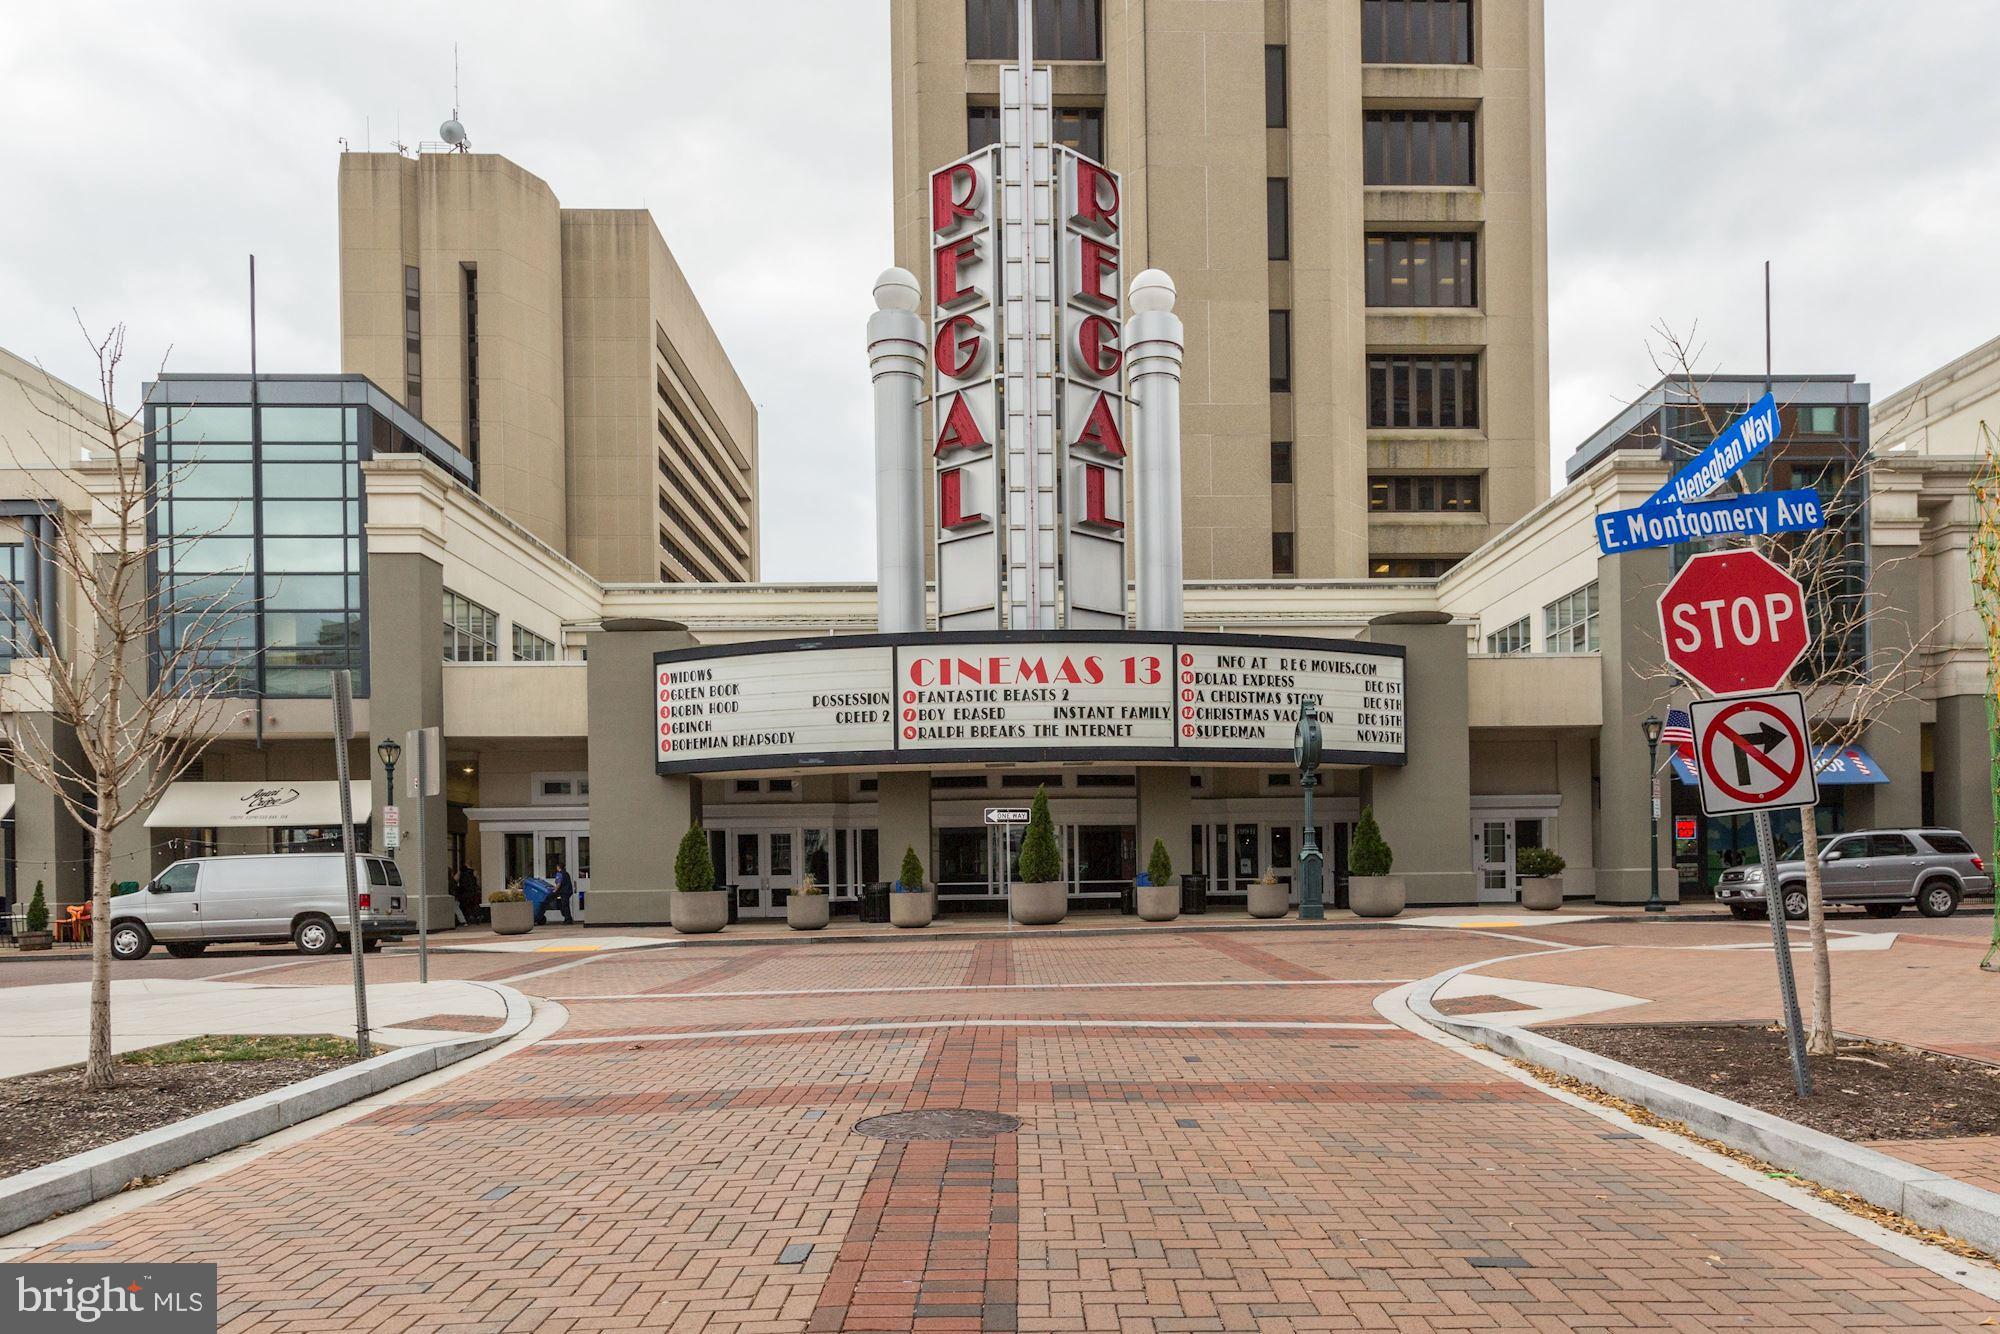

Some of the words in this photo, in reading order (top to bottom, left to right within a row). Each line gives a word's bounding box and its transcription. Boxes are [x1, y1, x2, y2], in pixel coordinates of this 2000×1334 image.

[933, 163, 988, 530] REGAL
[1072, 158, 1127, 530] REGAL
[1675, 439, 1743, 502] Heneghan
[1740, 409, 1774, 453] Way
[1777, 497, 1818, 527] Ave
[1672, 592, 1795, 653] STOP
[1218, 655, 1246, 668] INFO
[1251, 657, 1268, 669] AT
[670, 669, 712, 684] WIDOWS
[910, 656, 1104, 687] CINEMAS
[1120, 656, 1162, 685] 13
[1195, 673, 1237, 685] POLAR
[1243, 675, 1295, 687] EXPRESS
[1365, 680, 1384, 692] DEC
[671, 686, 705, 701] GREEN
[709, 683, 740, 697] BOOK
[813, 692, 890, 707] POSSESSION
[918, 689, 998, 703] FANTASTIC
[1004, 688, 1056, 702] BEASTS
[1062, 689, 1070, 701] 2
[1196, 690, 1205, 703] A
[1211, 690, 1282, 704] CHRISTMAS
[671, 704, 703, 718] ROBIN
[708, 700, 739, 714] HOOD
[1364, 697, 1382, 709] DEC
[835, 711, 878, 725] CREED
[881, 710, 890, 722] 2
[918, 709, 946, 721] BOY
[954, 707, 1006, 720] ERASED
[1054, 706, 1115, 719] INSTANT
[1121, 706, 1171, 719] FAMILY
[1196, 708, 1269, 721] CHRISTMAS
[1273, 710, 1334, 723] VACION
[1358, 713, 1378, 726] DEC
[672, 720, 712, 734] GRINCH
[918, 725, 965, 740] RALPH
[970, 724, 1026, 738] BREAKS
[1033, 724, 1059, 737] THE
[1065, 724, 1133, 737] INTERNET
[1196, 726, 1266, 738] SUPERMAN
[672, 736, 729, 752] BOHEMIAN
[733, 732, 795, 747] RHAPSODY
